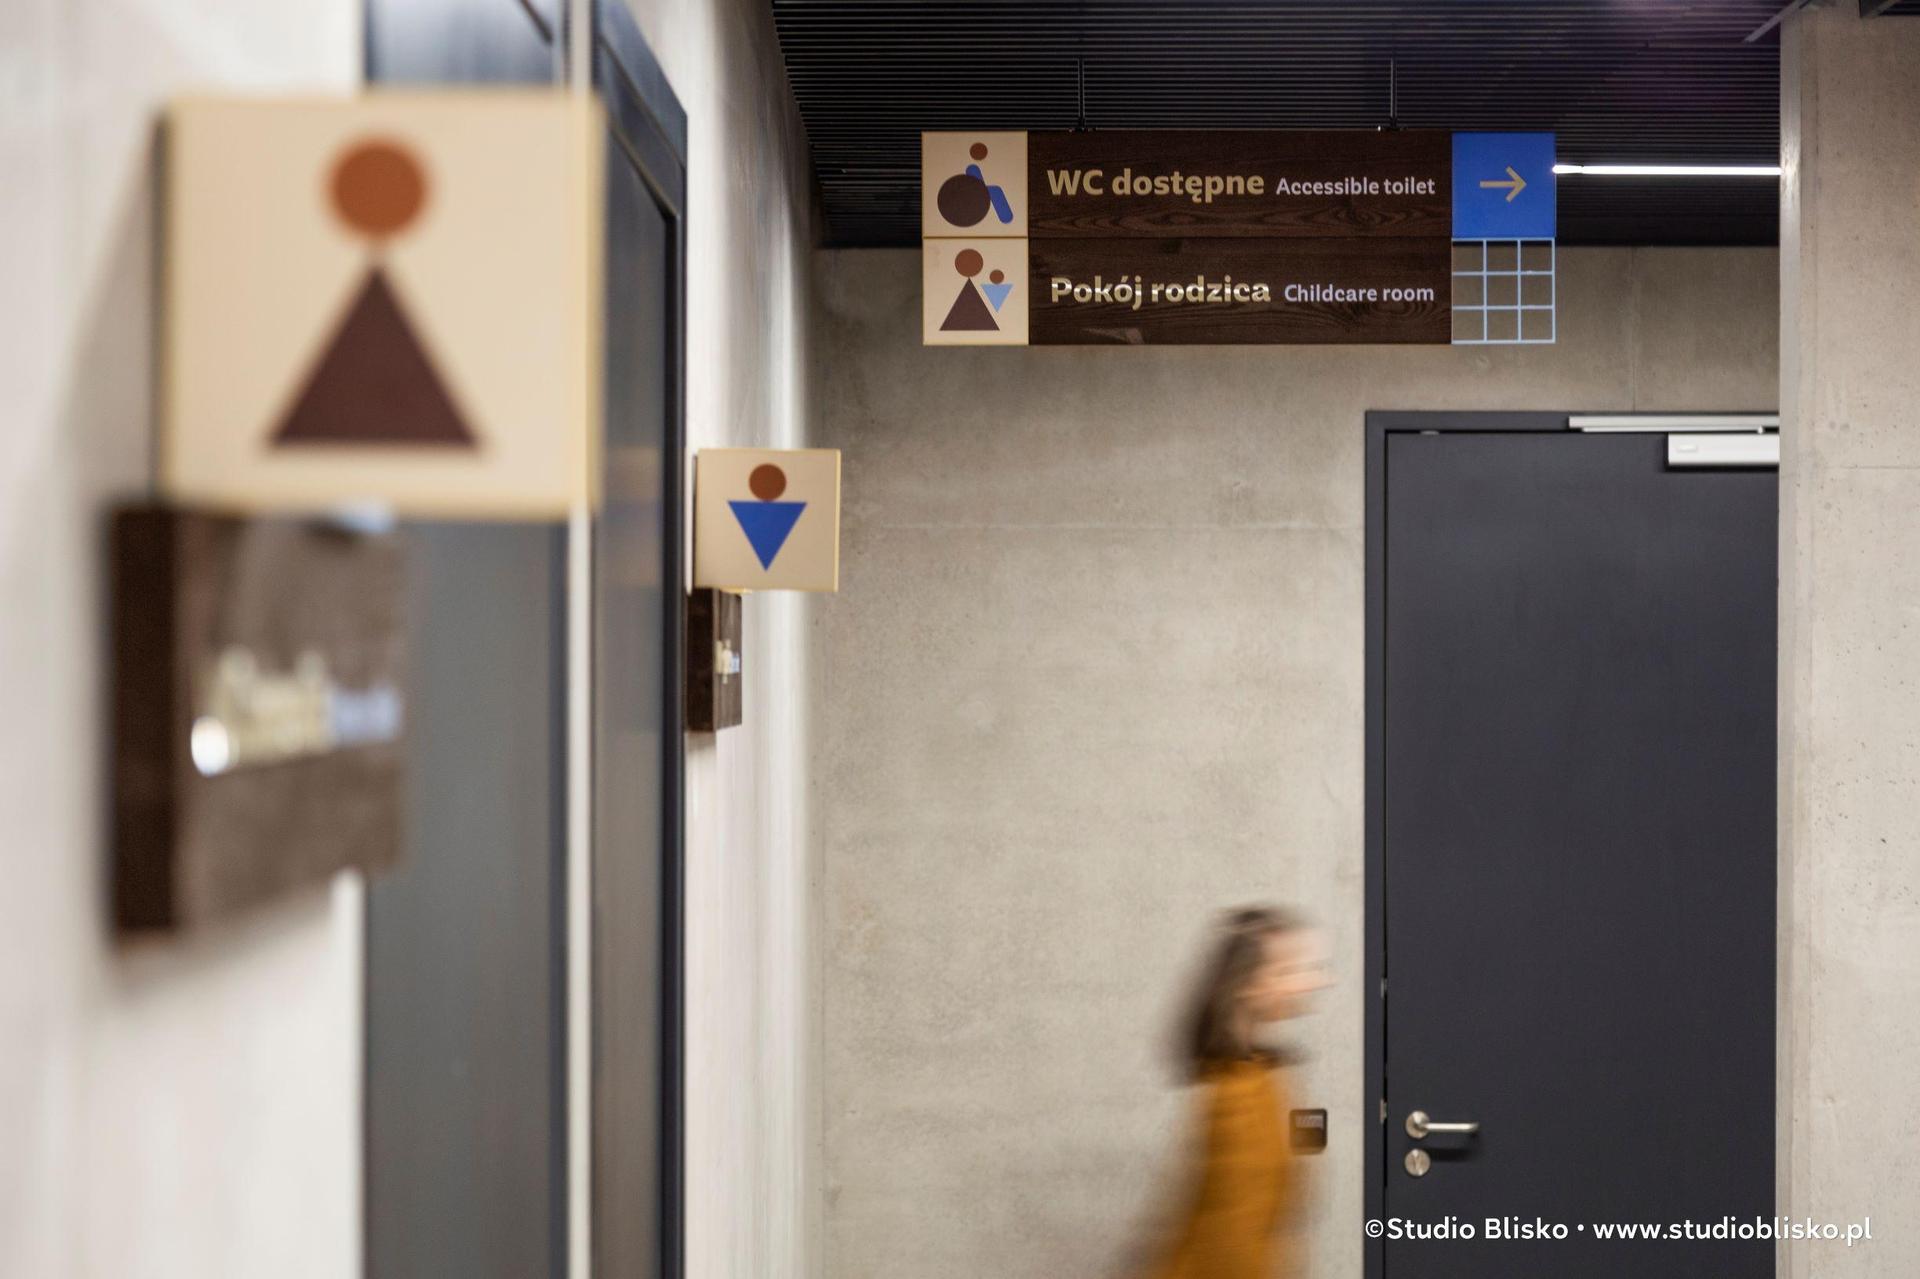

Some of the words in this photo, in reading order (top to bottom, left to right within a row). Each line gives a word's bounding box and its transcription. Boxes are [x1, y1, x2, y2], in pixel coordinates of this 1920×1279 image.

[1047, 169, 1103, 196] WC
[1112, 168, 1265, 203] dostępne
[1276, 177, 1379, 196] Accessible
[1384, 177, 1436, 196] toilet
[1051, 275, 1143, 311] Pokój
[1151, 275, 1271, 304] rodzica
[1284, 284, 1378, 302] Childcare
[1382, 287, 1434, 302] room
